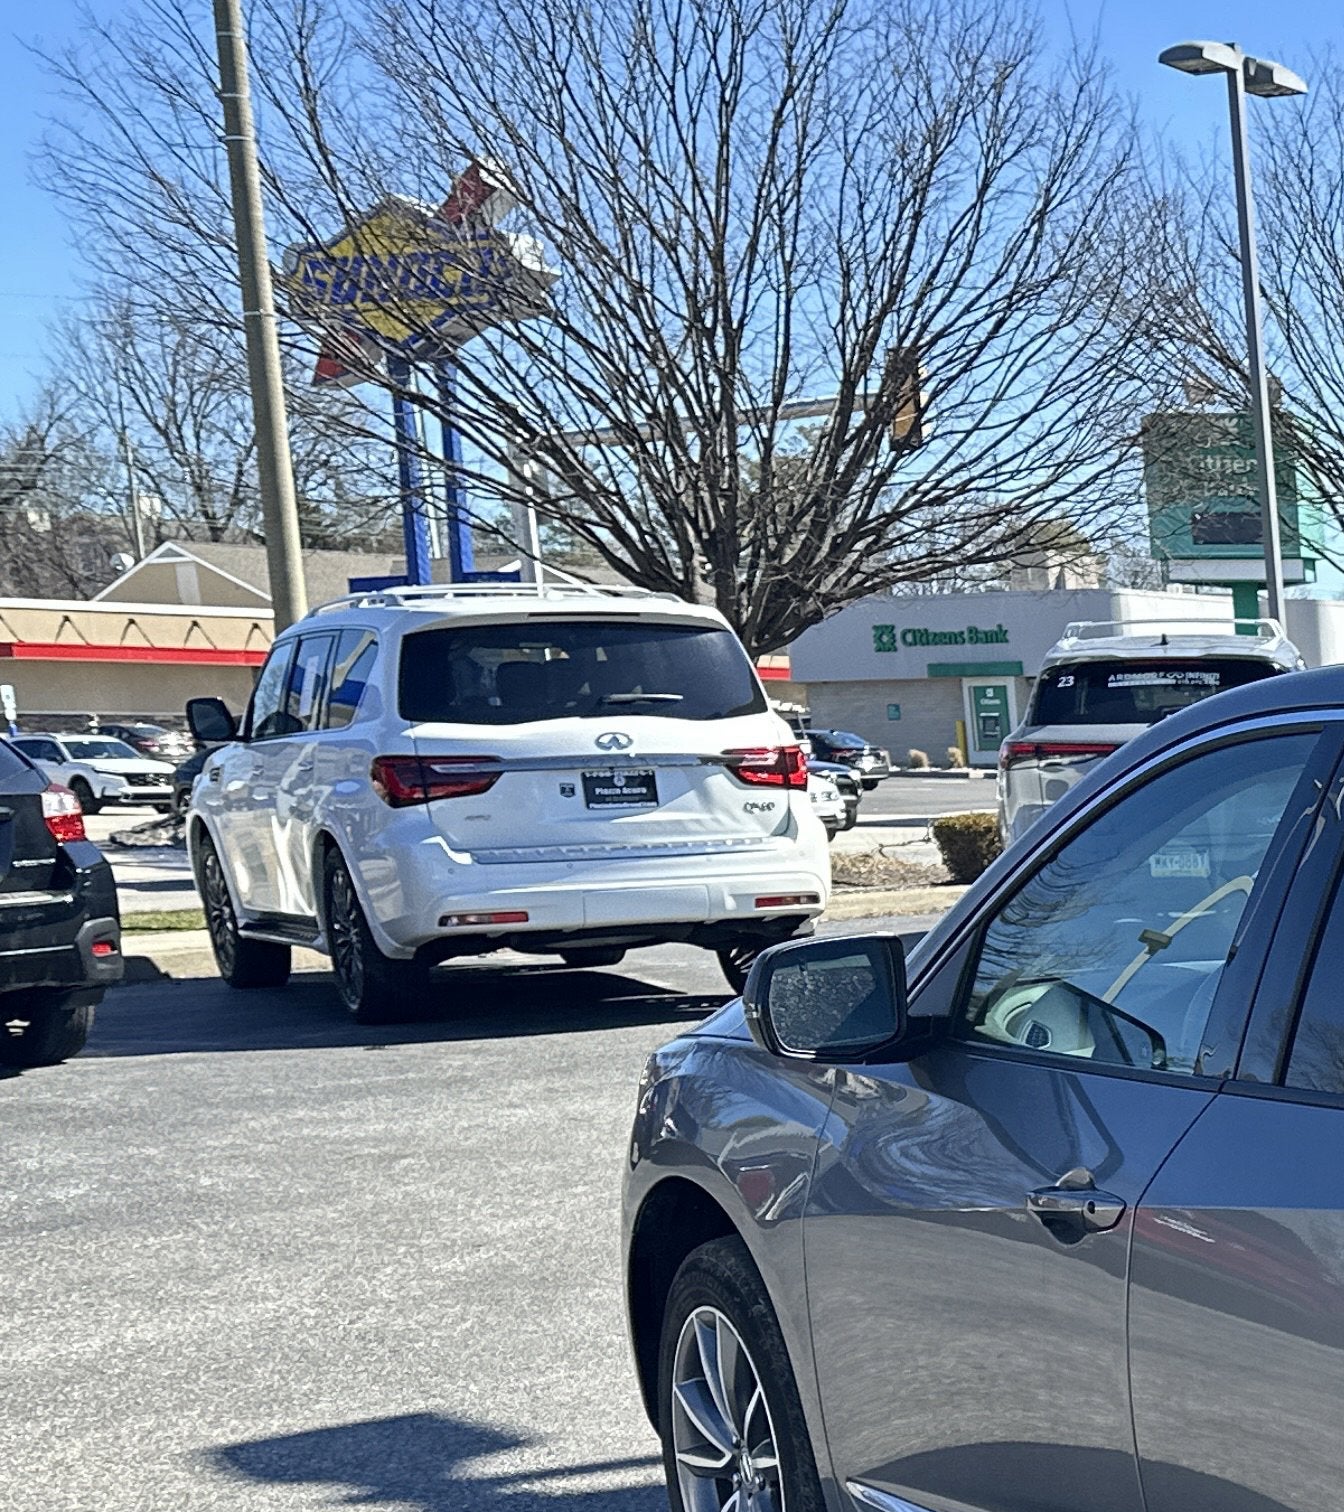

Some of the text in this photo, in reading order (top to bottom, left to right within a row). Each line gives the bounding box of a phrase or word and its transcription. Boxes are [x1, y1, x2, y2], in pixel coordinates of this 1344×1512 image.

[901, 624, 1009, 647] Citizens Bank
[1057, 675, 1075, 688] 23
